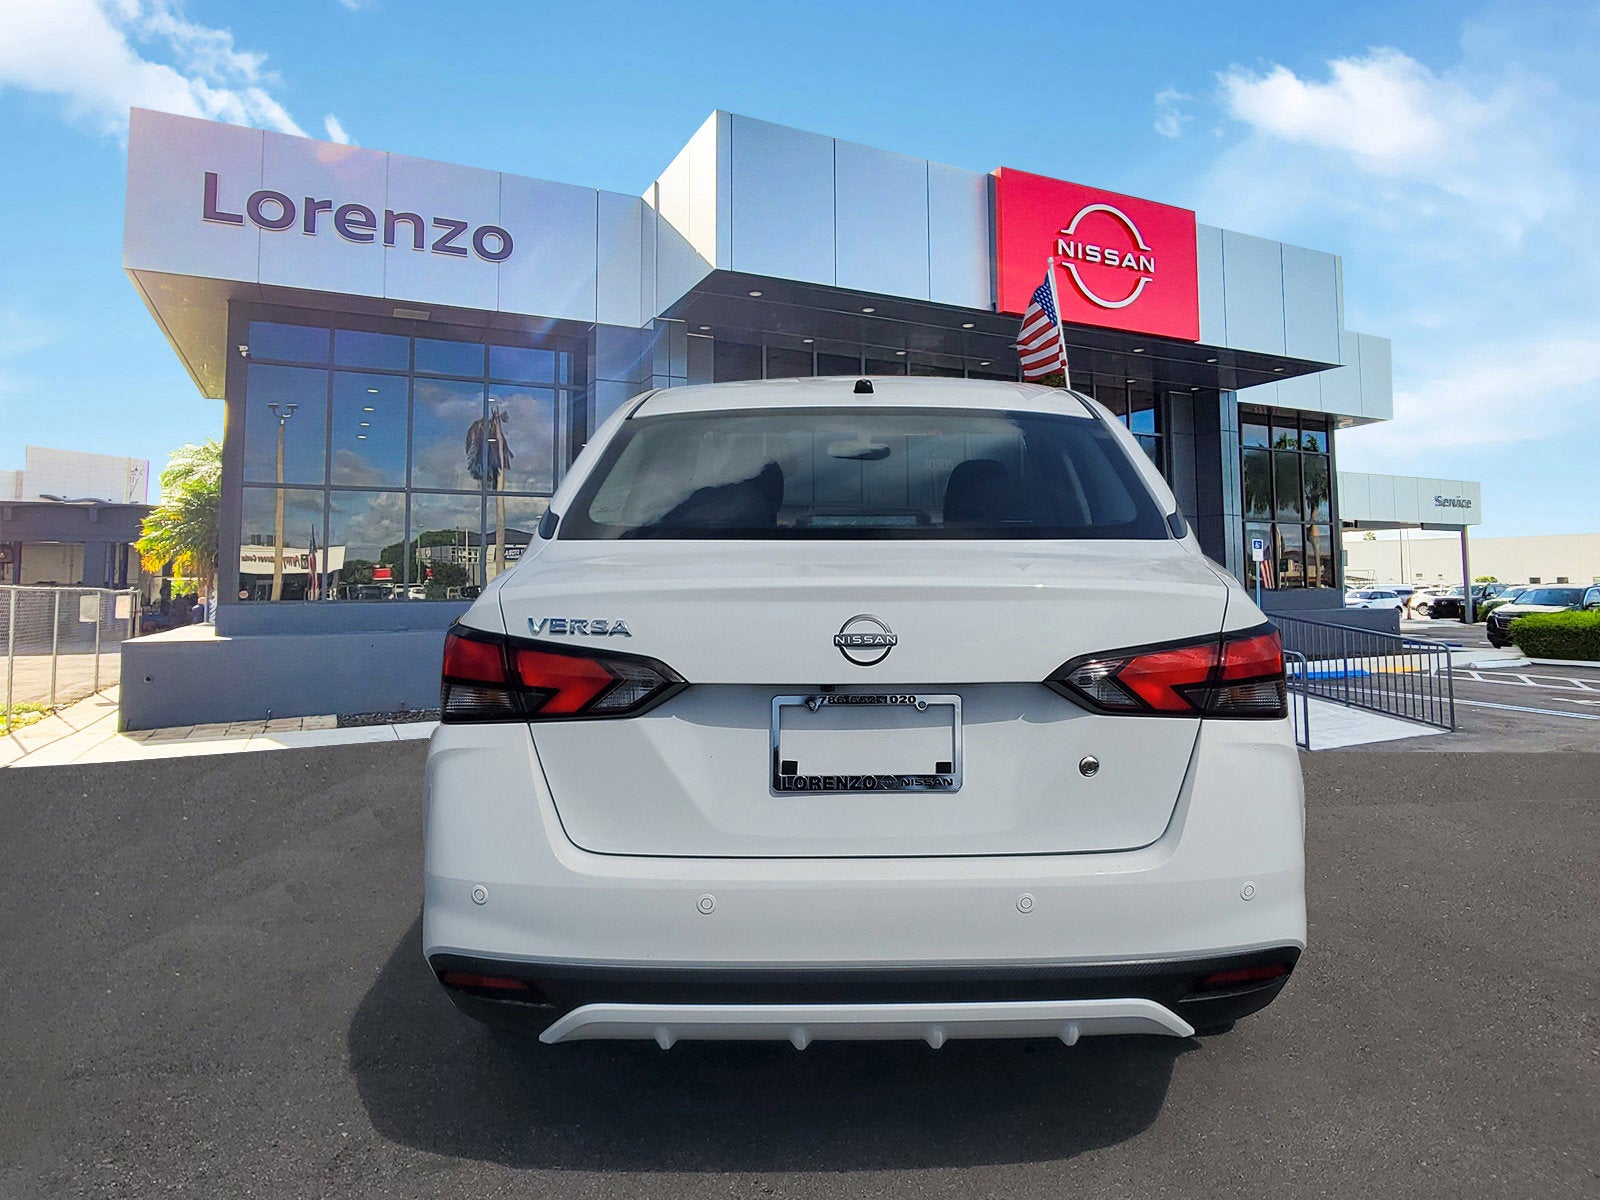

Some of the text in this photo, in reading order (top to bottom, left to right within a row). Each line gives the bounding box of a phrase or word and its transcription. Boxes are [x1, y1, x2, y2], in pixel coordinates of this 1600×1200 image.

[202, 171, 515, 263] Lorenzo
[1057, 238, 1156, 273] NISSAN
[1434, 495, 1472, 508] Service
[527, 616, 633, 638] VERSA
[834, 635, 898, 646] NISSAN
[780, 775, 878, 790] LORENZO
[900, 778, 954, 787] NISSAN
